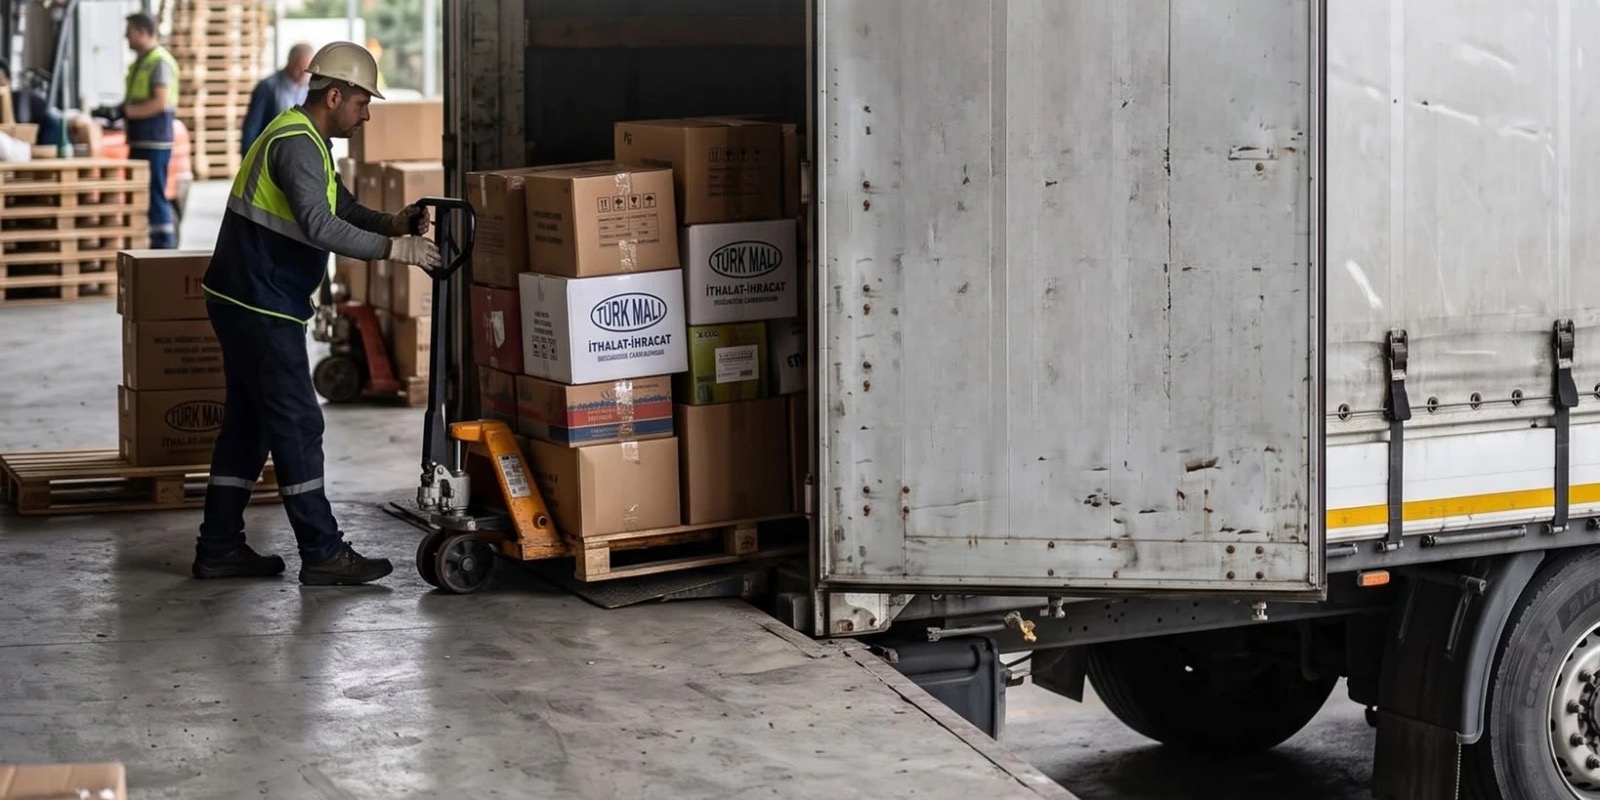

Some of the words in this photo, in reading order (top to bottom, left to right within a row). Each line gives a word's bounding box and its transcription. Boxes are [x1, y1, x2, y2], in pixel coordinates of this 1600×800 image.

[714, 246, 747, 273] TÜRK
[749, 246, 777, 273] MALI
[705, 281, 786, 297] İTHALAT-İHRACAT
[596, 298, 630, 327] TÜRK
[632, 298, 662, 326] MALI
[588, 333, 672, 353] İTHALAT-İHRACAT
[171, 403, 201, 428] TÜRK
